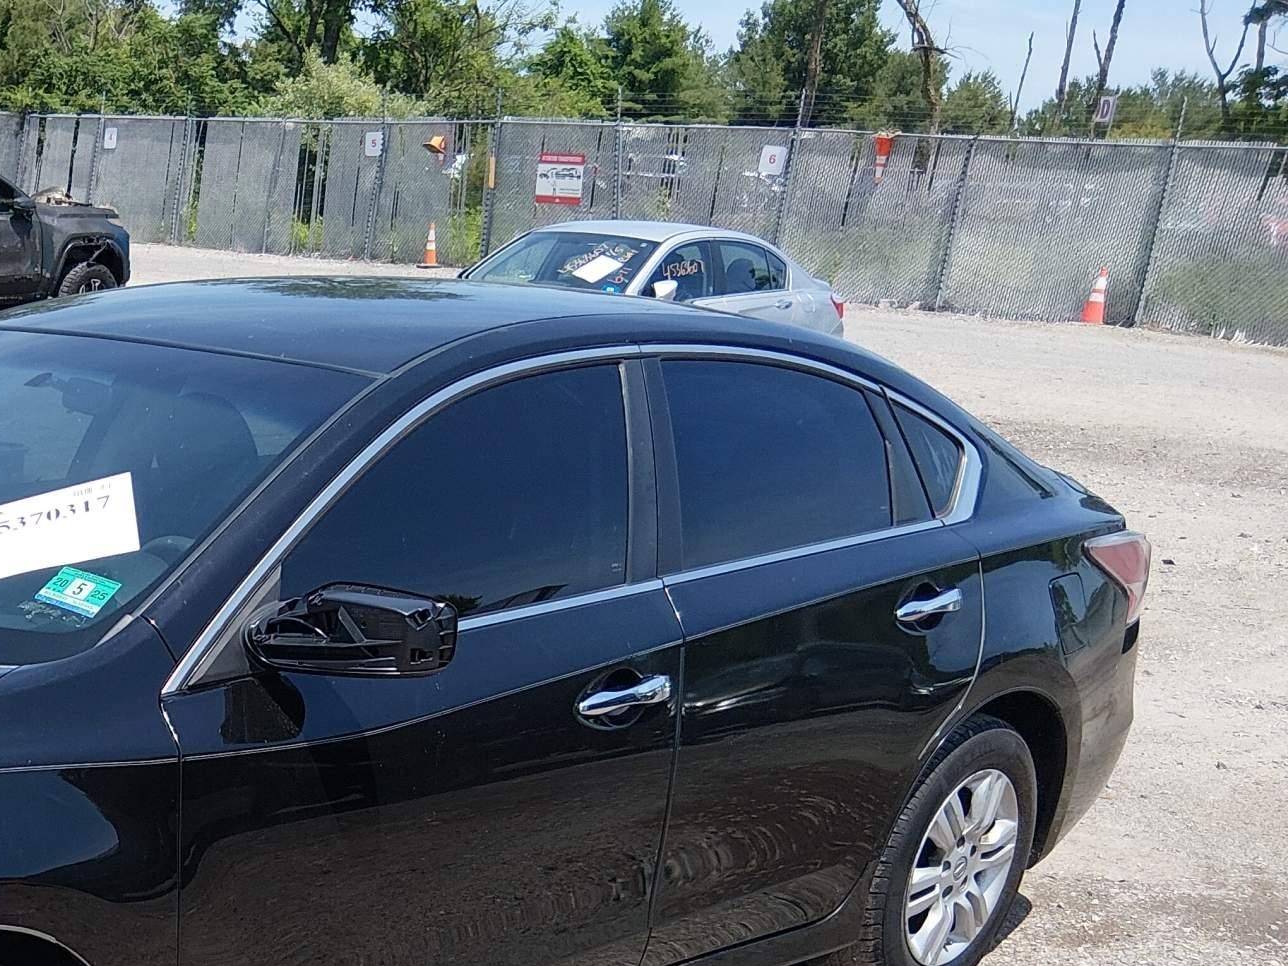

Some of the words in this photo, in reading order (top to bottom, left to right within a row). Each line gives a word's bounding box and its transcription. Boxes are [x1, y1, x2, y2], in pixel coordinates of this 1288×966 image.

[371, 138, 377, 148] 5
[768, 154, 777, 164] 6
[52, 577, 69, 588] 20
[72, 583, 88, 596] 5
[90, 590, 108, 601] 25
